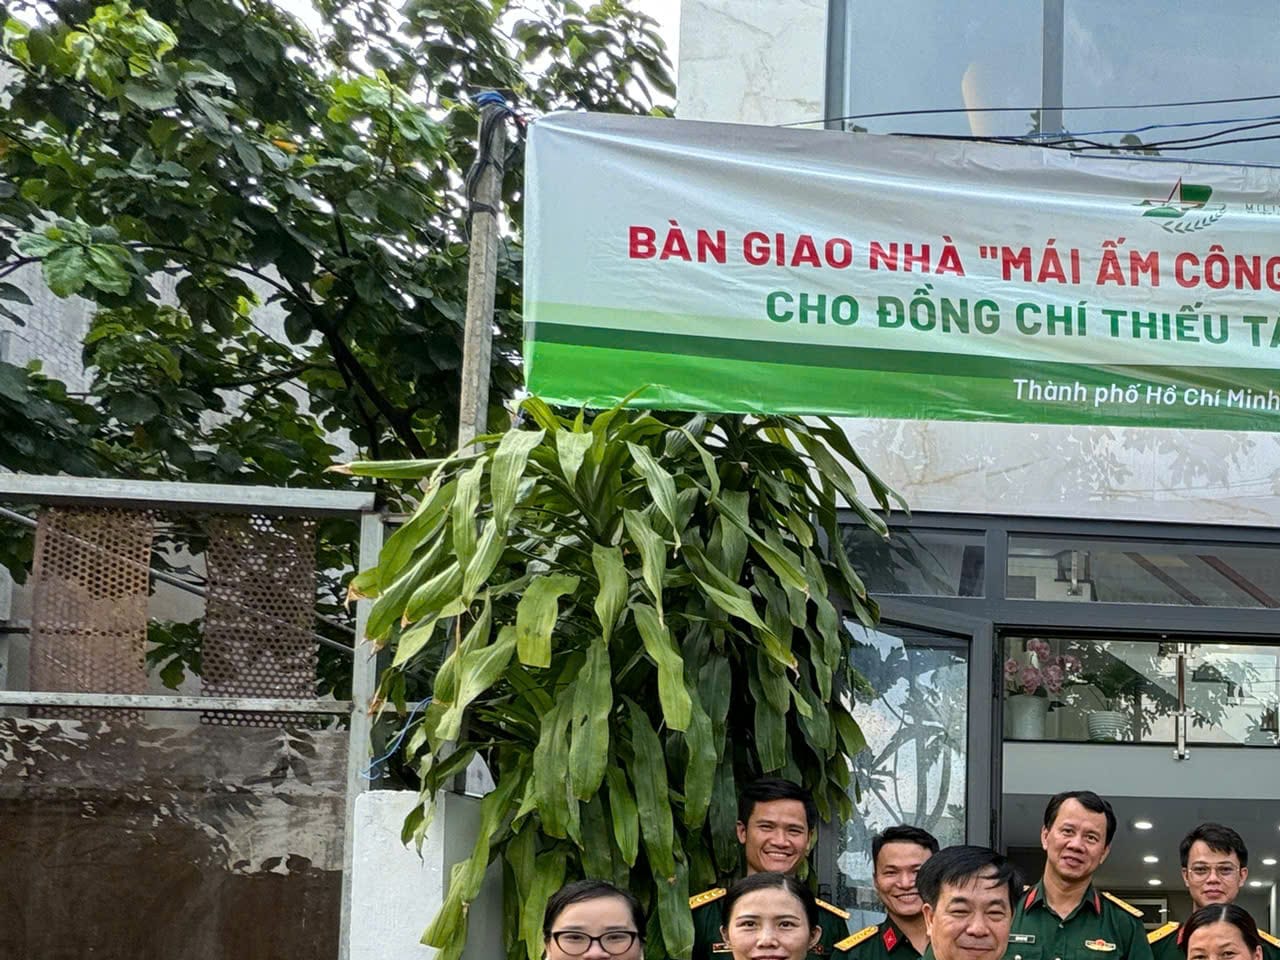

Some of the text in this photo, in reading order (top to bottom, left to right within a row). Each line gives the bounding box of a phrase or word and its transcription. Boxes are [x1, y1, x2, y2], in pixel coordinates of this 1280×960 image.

[628, 219, 727, 264] BÀN
[743, 231, 853, 269] GIAO
[869, 235, 966, 276] NHÀ
[979, 238, 1081, 285] "MÁI
[1096, 237, 1160, 287] ẤM
[766, 290, 860, 326] CHO
[876, 283, 1001, 335] ĐỒNG
[1016, 300, 1087, 337] CHÍ
[1102, 302, 1229, 345] THIẾU
[1013, 379, 1088, 401] Thành
[1094, 383, 1142, 407] phố
[1146, 384, 1177, 405] Hồ
[1183, 388, 1220, 407] Chí
